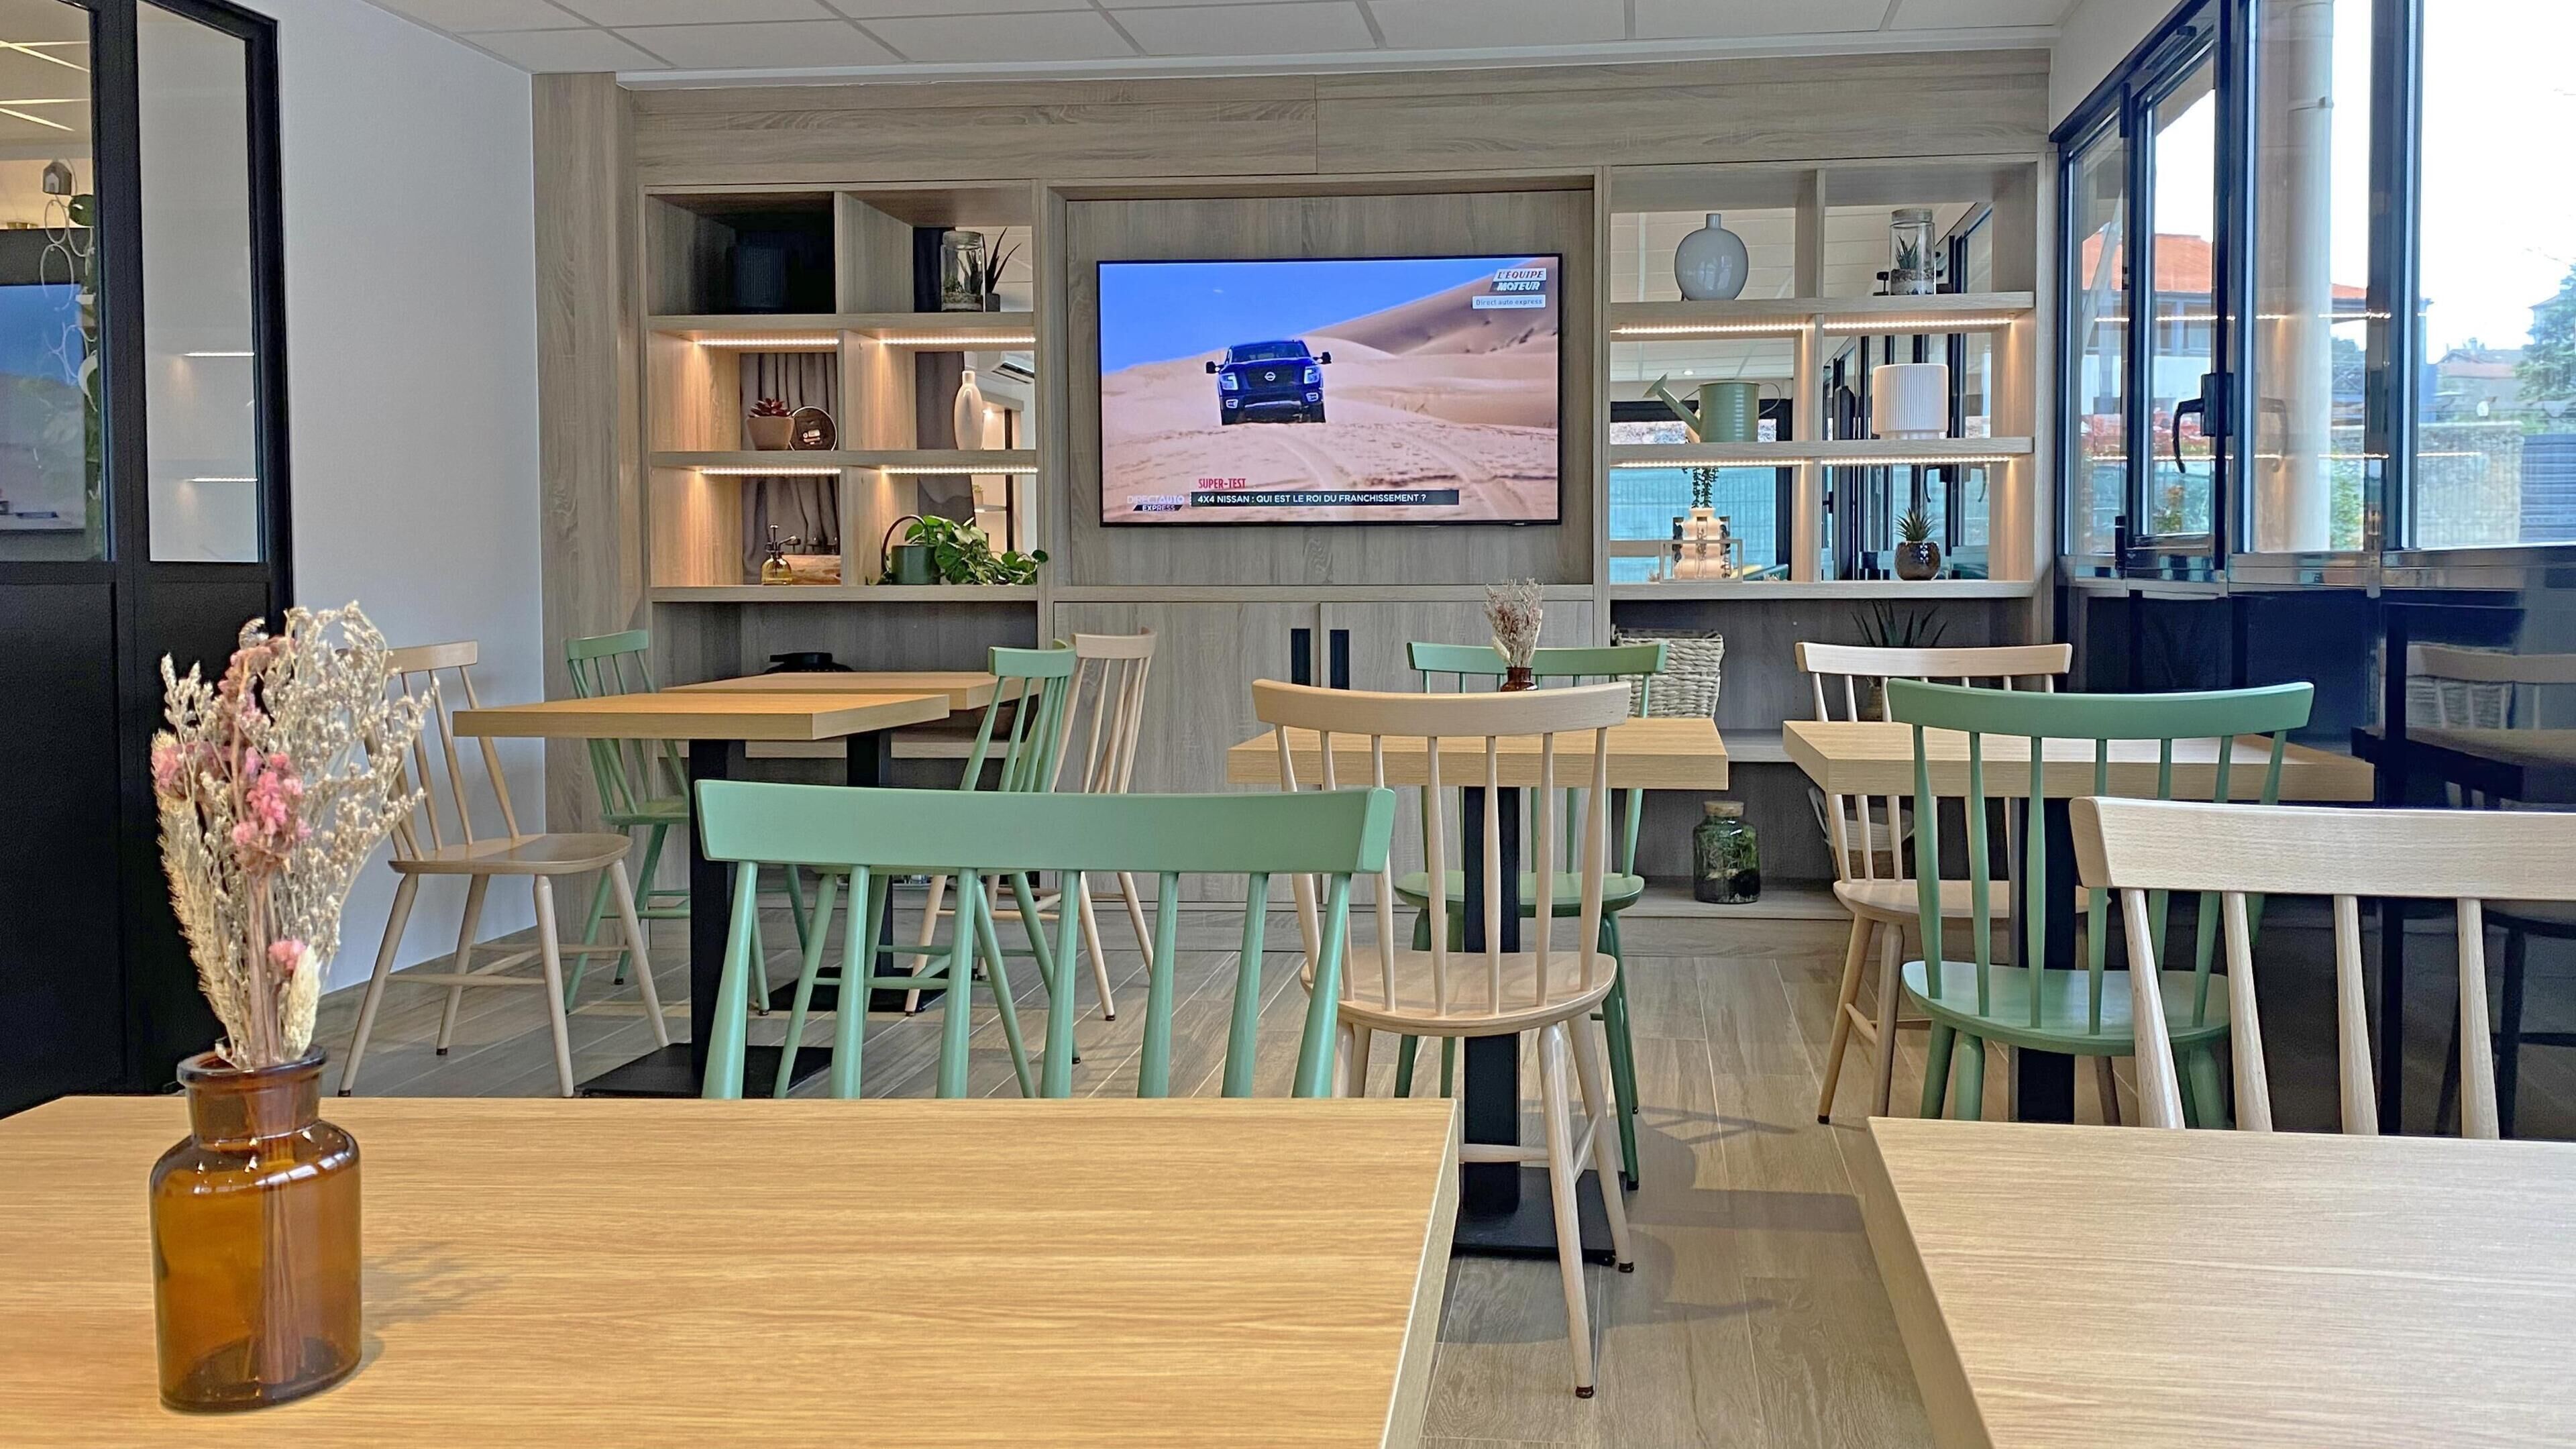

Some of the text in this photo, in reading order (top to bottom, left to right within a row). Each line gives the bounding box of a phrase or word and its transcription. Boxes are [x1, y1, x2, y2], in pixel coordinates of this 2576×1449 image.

[1497, 282, 1540, 290] MOTEUR
[1198, 478, 1246, 489] SUPER-TEST
[1197, 495, 1215, 503] 4X4
[1217, 495, 1250, 503] NISSAN
[1256, 495, 1273, 503] QUI
[1275, 494, 1291, 502] EST
[1293, 494, 1303, 502] LE
[1306, 494, 1322, 502] ROI
[1324, 494, 1337, 502] DU
[1339, 494, 1419, 502] FRANCHISSEMENT
